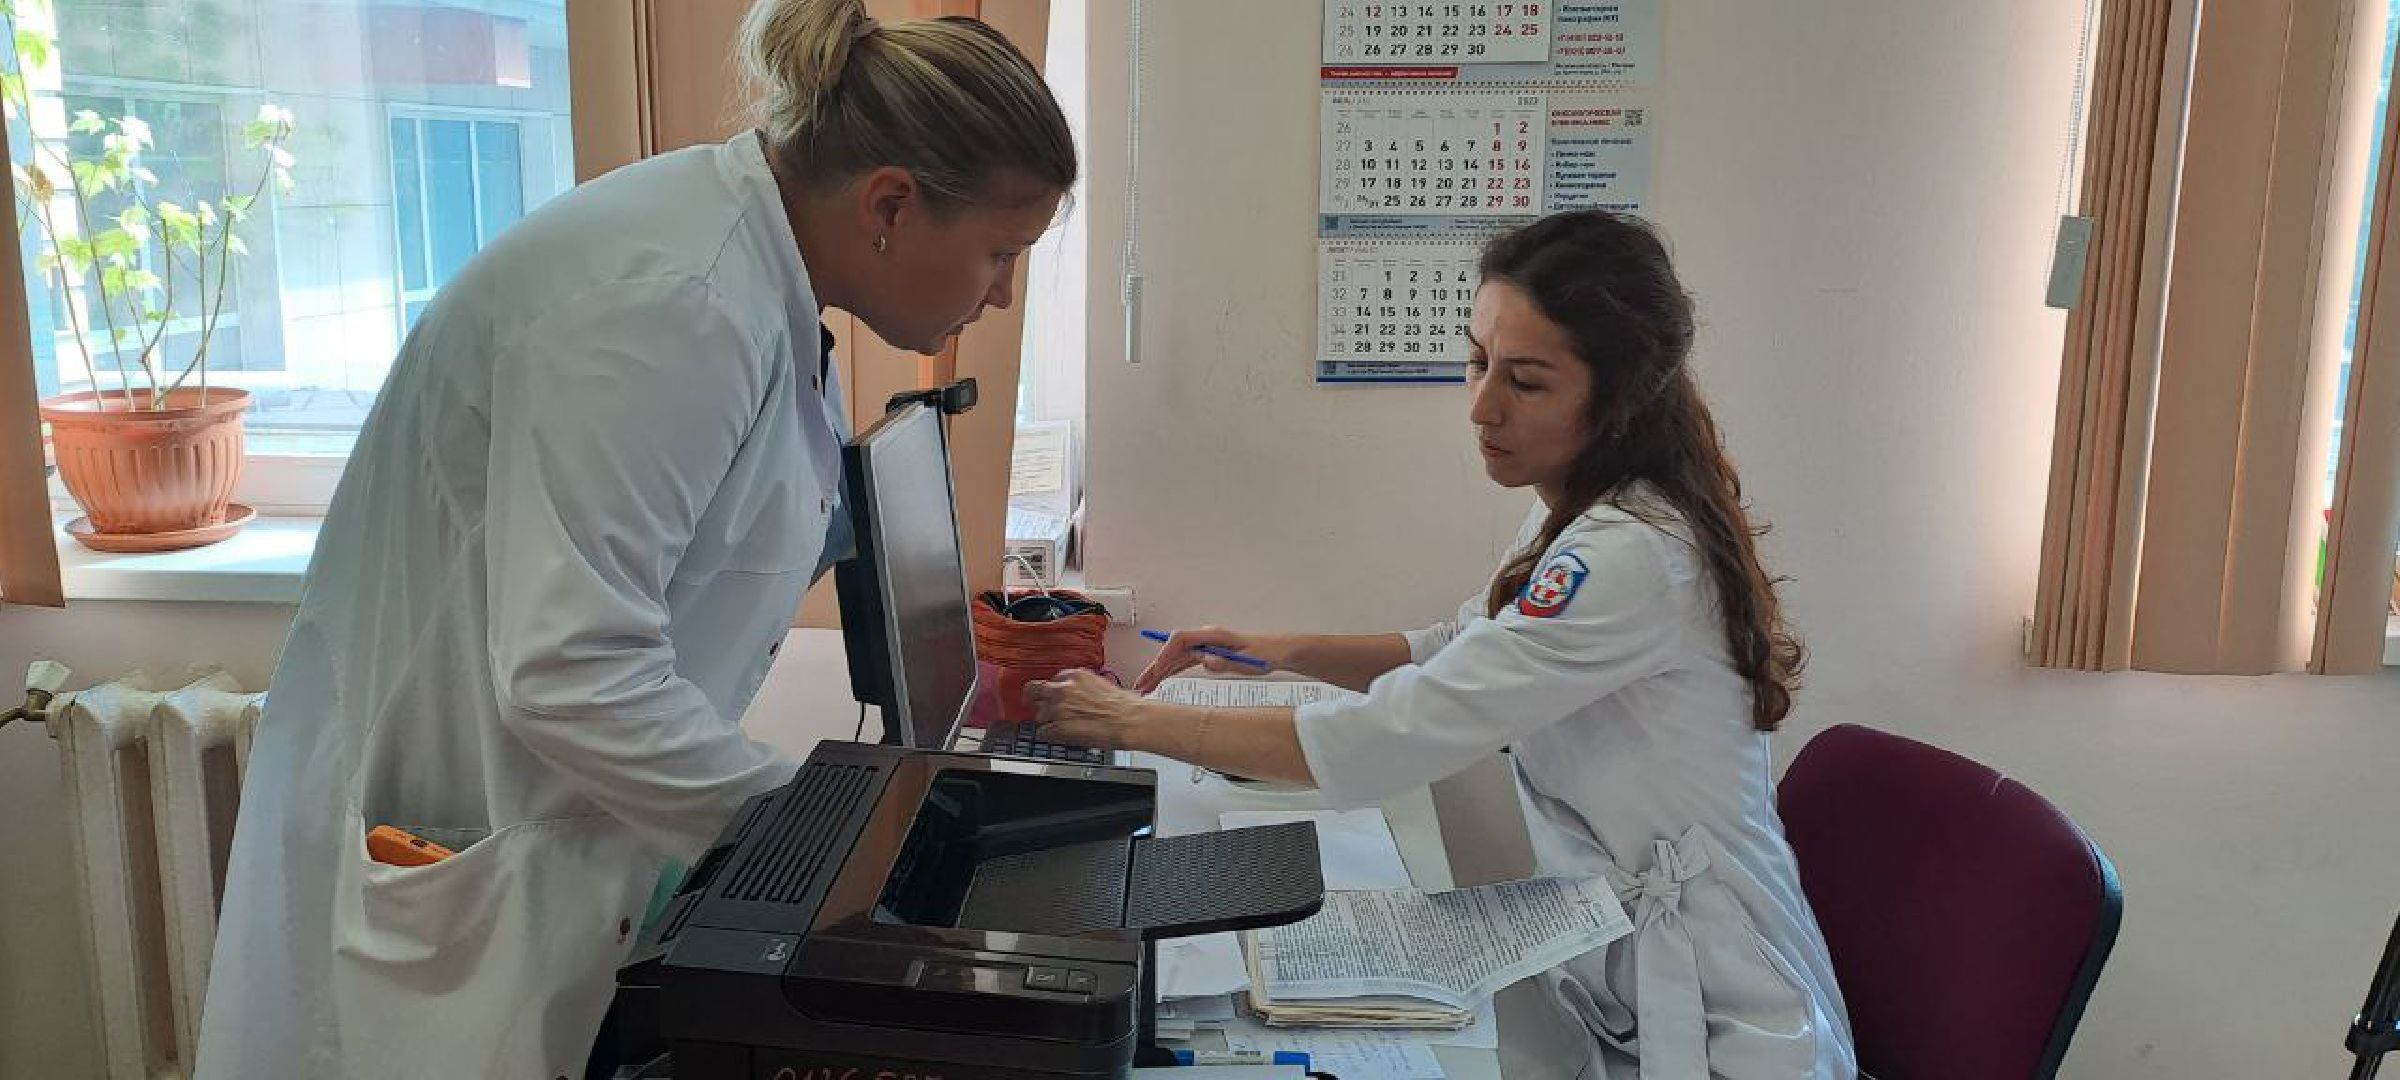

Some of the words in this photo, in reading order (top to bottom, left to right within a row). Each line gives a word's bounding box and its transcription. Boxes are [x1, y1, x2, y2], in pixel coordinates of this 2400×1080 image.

[1366, 5, 1381, 17] 12
[1391, 5, 1407, 17] 13
[1417, 5, 1433, 17] 14
[1444, 5, 1459, 17] 15
[1470, 5, 1486, 17] 16
[1496, 5, 1512, 17] 17
[1522, 5, 1538, 17] 18
[1366, 24, 1381, 36] 19
[1391, 24, 1407, 36] 20
[1417, 24, 1432, 36] 21
[1442, 24, 1459, 36] 22
[1470, 24, 1486, 36] 23
[1495, 24, 1512, 36] 24
[1522, 24, 1538, 36] 25
[1364, 44, 1380, 56] 26
[1391, 44, 1407, 56] 27
[1416, 44, 1433, 56] 28
[1441, 44, 1458, 56] 29
[1467, 44, 1486, 56] 30
[1494, 122, 1501, 135] 1
[1519, 121, 1529, 134] 2
[1364, 140, 1373, 151] 3
[1389, 140, 1398, 151] 4
[1415, 140, 1424, 151] 5
[1441, 140, 1450, 151] 6
[1467, 140, 1476, 151] 7
[1492, 140, 1501, 151] 8
[1518, 140, 1527, 151] 9
[1361, 159, 1376, 171] 10
[1385, 159, 1399, 171] 11
[1411, 159, 1427, 171] 12
[1438, 159, 1453, 171] 13
[1464, 159, 1479, 171] 14
[1489, 159, 1504, 171] 15
[1515, 159, 1530, 171] 16
[1361, 178, 1376, 190] 17
[1385, 178, 1401, 190] 18
[1411, 178, 1427, 190] 19
[1436, 178, 1453, 190] 20
[1462, 178, 1477, 190] 21
[1487, 178, 1504, 190] 22
[1513, 178, 1530, 190] 23
[1385, 196, 1401, 207] 25
[1410, 196, 1426, 207] 26
[1435, 196, 1451, 207] 27
[1460, 196, 1477, 207] 28
[1486, 196, 1503, 207] 29
[1513, 196, 1530, 207] 30
[1385, 271, 1392, 282] 1
[1410, 271, 1418, 282] 2
[1434, 271, 1442, 282] 3
[1458, 271, 1467, 282] 4
[1361, 288, 1368, 300] 7
[1383, 288, 1392, 300] 8
[1410, 288, 1418, 300] 9
[1430, 288, 1447, 300] 10
[1456, 288, 1471, 300] 11
[1357, 307, 1371, 317] 14
[1380, 307, 1396, 317] 15
[1406, 307, 1421, 317] 16
[1431, 307, 1446, 317] 17
[1456, 307, 1472, 317] 18
[1355, 324, 1369, 336] 21
[1380, 324, 1396, 336] 22
[1404, 324, 1421, 336] 23
[1430, 324, 1446, 336] 24
[1355, 343, 1371, 353] 28
[1380, 343, 1396, 353] 29
[1404, 343, 1420, 353] 30
[1429, 343, 1444, 353] 31
